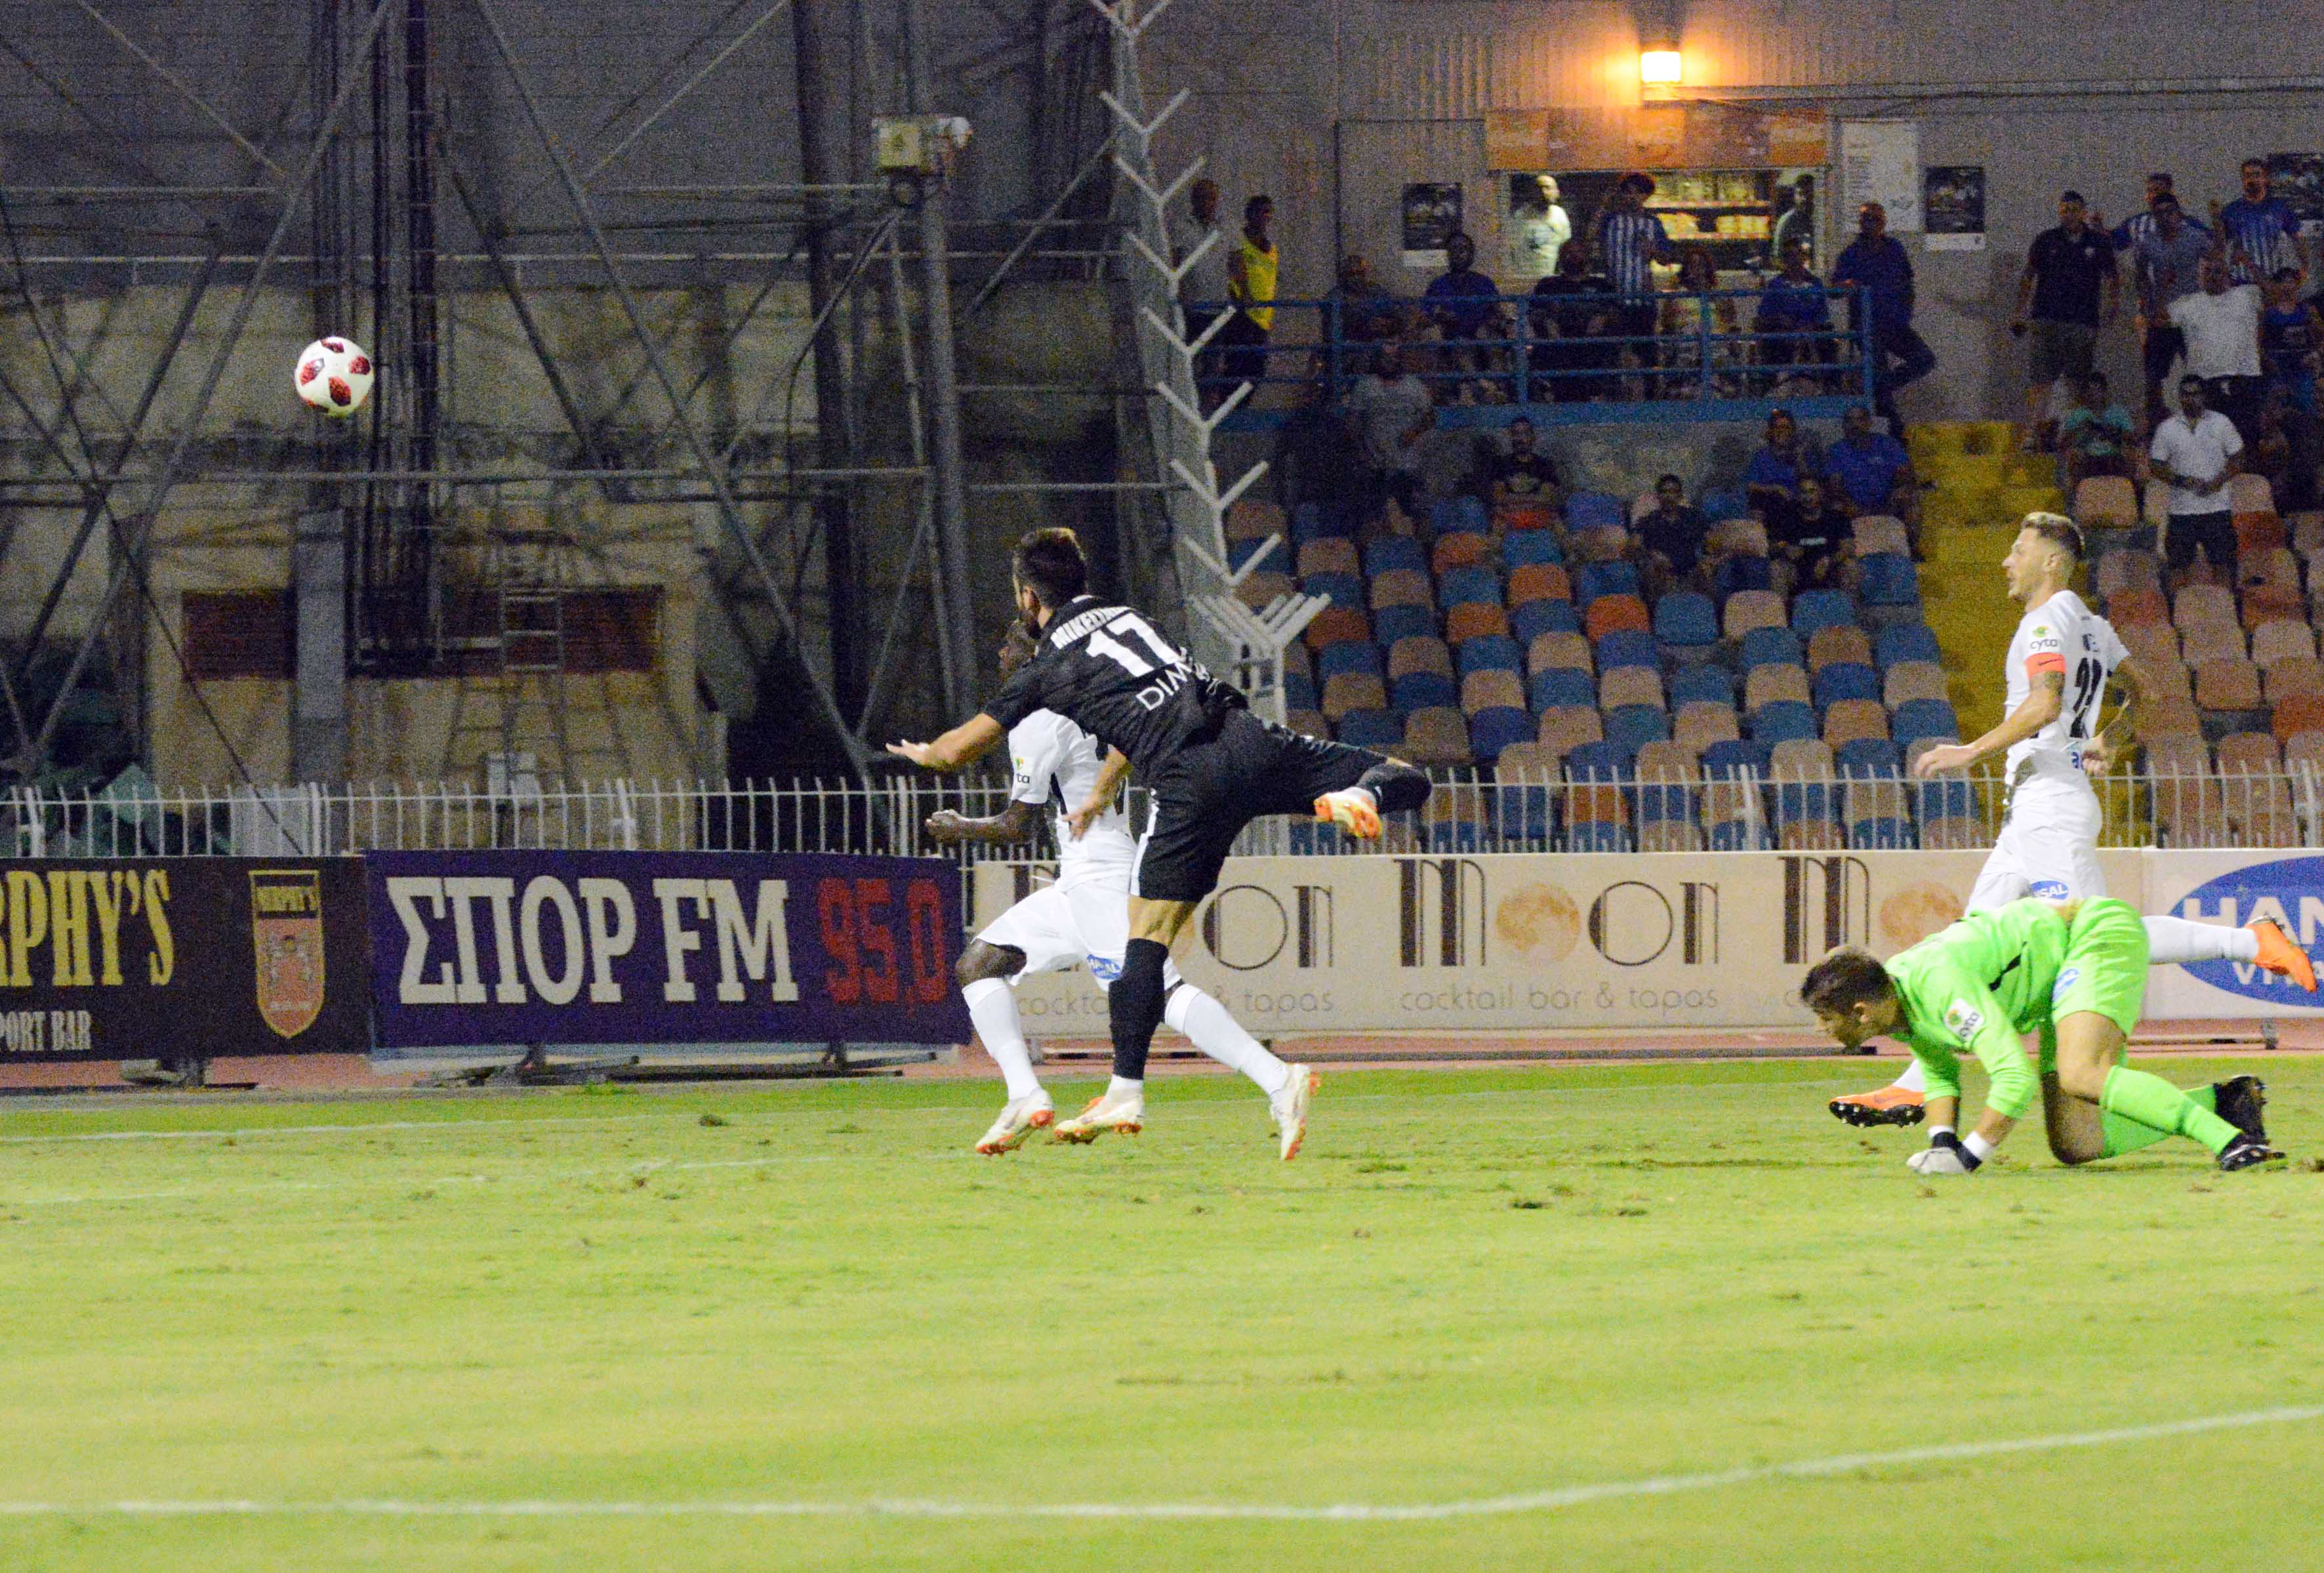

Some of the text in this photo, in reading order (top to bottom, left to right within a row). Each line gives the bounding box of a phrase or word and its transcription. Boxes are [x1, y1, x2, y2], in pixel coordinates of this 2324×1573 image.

[1086, 613, 1183, 678] 17
[2029, 639, 2058, 651] cyta
[0, 868, 174, 986] PHY'S
[386, 875, 637, 1005] ΣΠΟΡ
[653, 878, 798, 1002] FM
[1017, 987, 1110, 1016] cockta
[1244, 991, 1334, 1020] tapas
[1400, 981, 1719, 1016] cocktail bar & tapas
[51, 1010, 92, 1052] BAR
